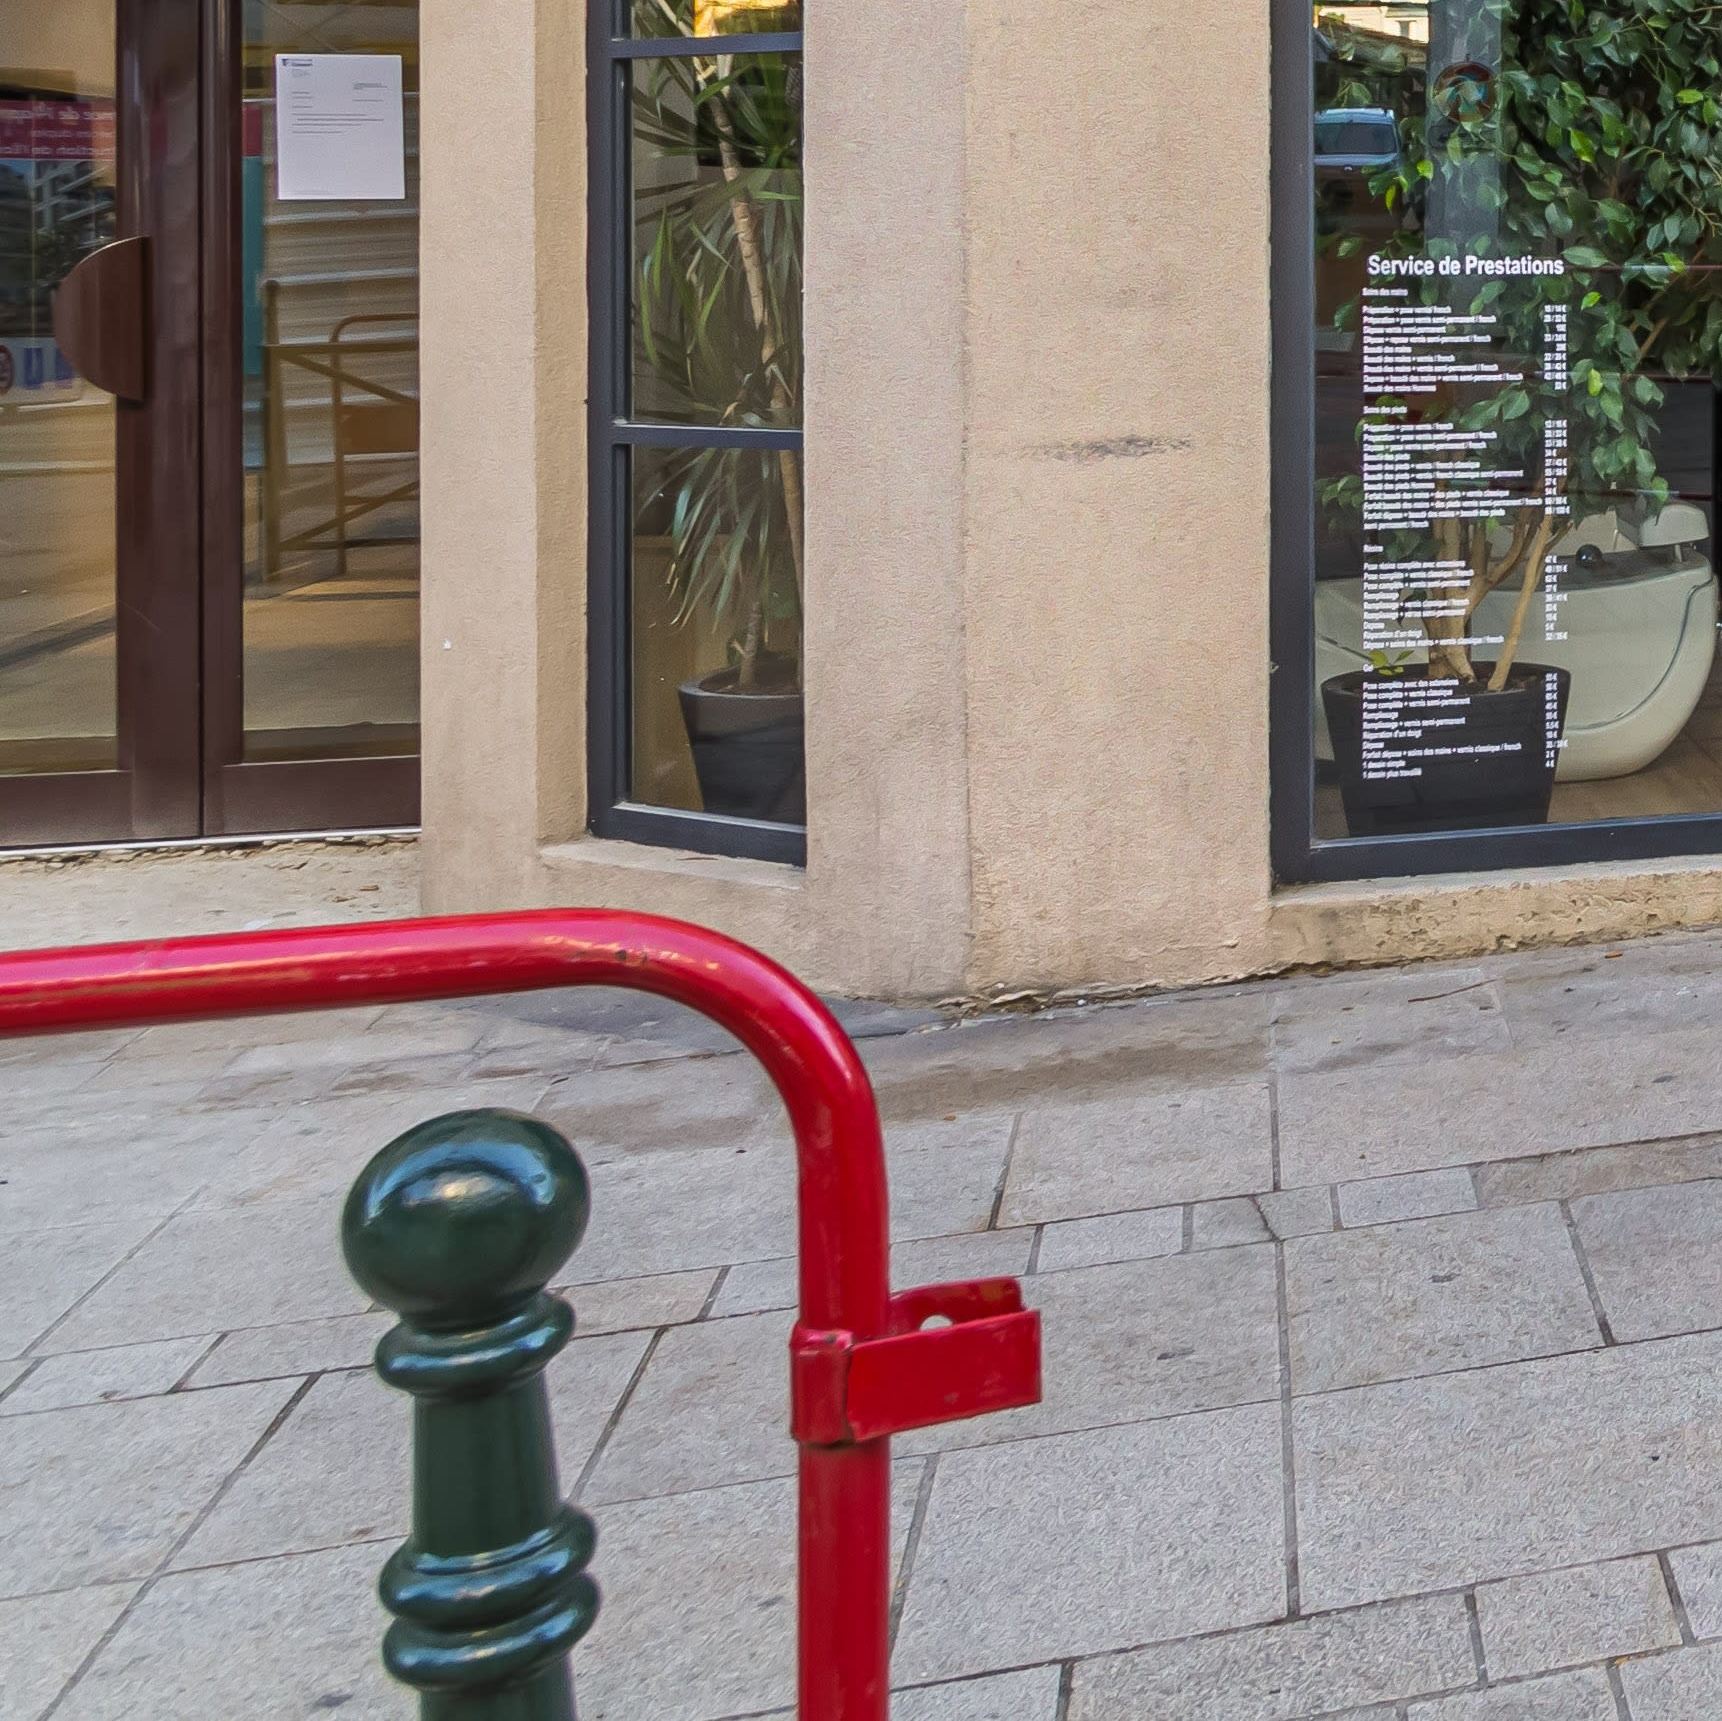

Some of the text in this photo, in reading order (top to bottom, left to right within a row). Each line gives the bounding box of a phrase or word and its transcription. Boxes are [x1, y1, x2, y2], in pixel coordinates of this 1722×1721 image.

[1367, 254, 1565, 276] Service de Prestations
